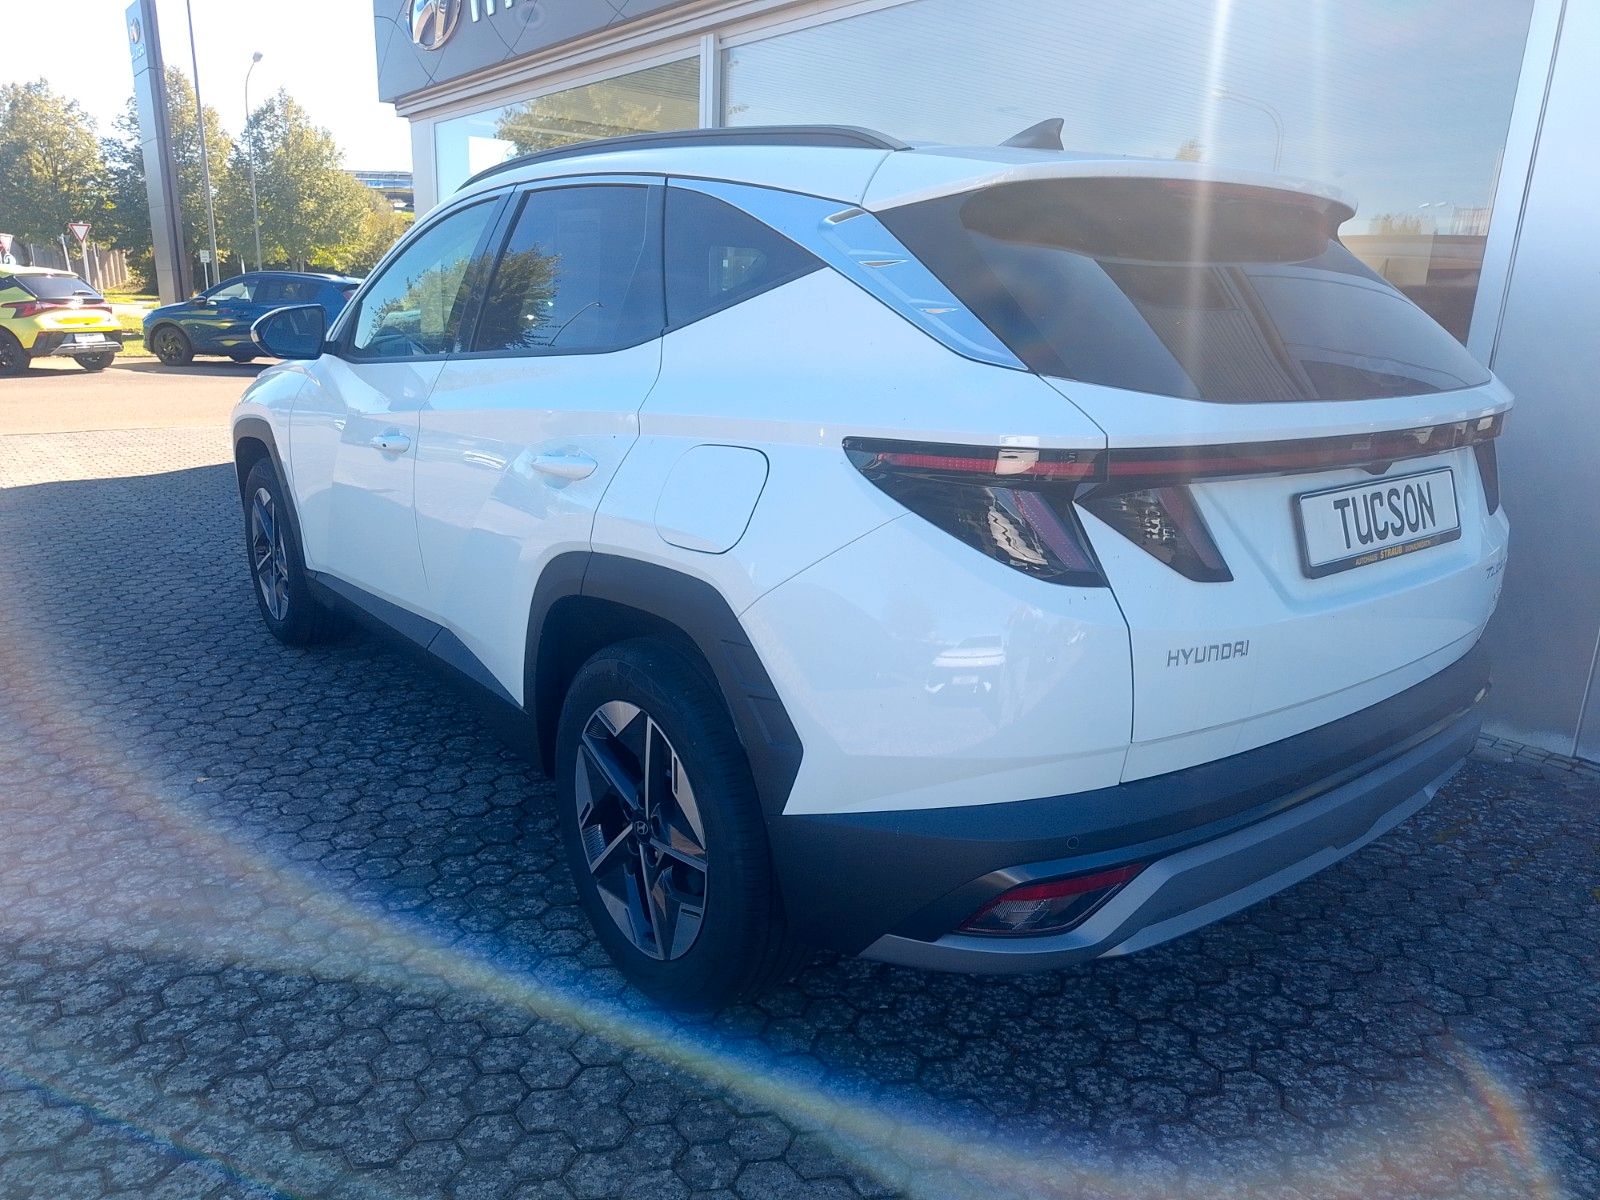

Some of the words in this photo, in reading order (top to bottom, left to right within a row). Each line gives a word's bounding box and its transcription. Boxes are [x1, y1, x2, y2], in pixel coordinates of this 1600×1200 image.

[1333, 481, 1436, 549] TUCSON
[1380, 545, 1403, 559] STRAUB
[1167, 639, 1249, 667] HYUNDAI
